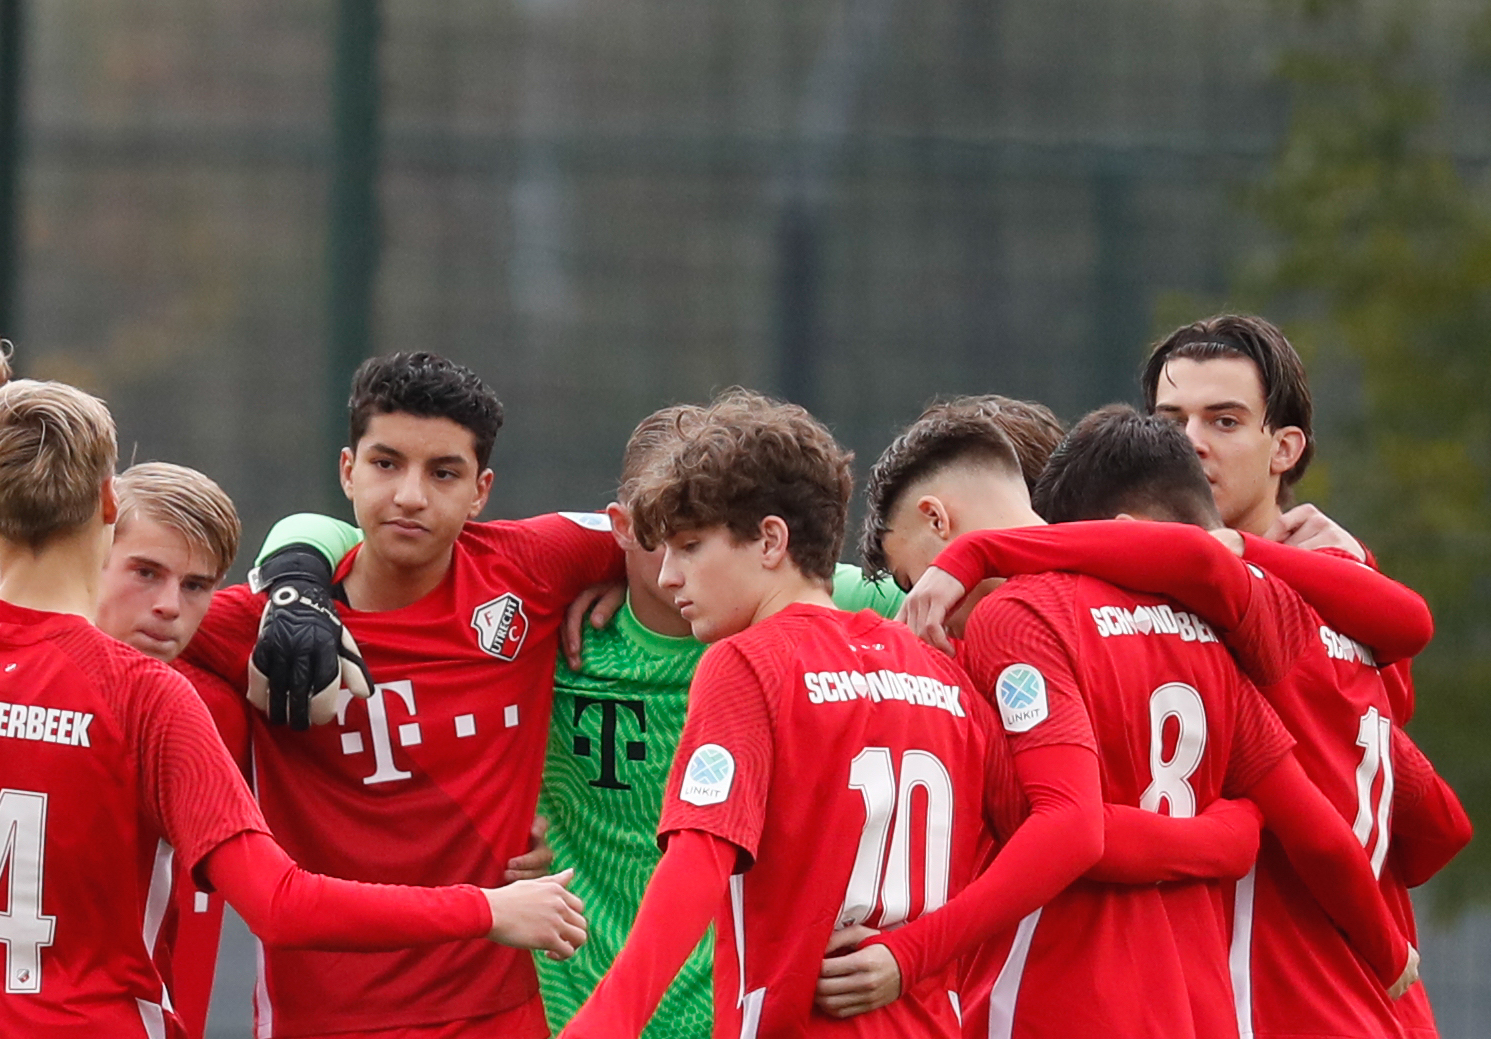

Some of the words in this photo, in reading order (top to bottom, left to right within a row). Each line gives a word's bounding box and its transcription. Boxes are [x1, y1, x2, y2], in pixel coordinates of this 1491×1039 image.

[491, 599, 517, 653] UTRECHT
[509, 625, 520, 642] C
[338, 679, 421, 785] T
[573, 699, 647, 790] T
[1007, 709, 1040, 725] LINKIT
[1140, 681, 1207, 818] 8
[685, 786, 721, 797] LINKIT
[834, 746, 953, 931] 10
